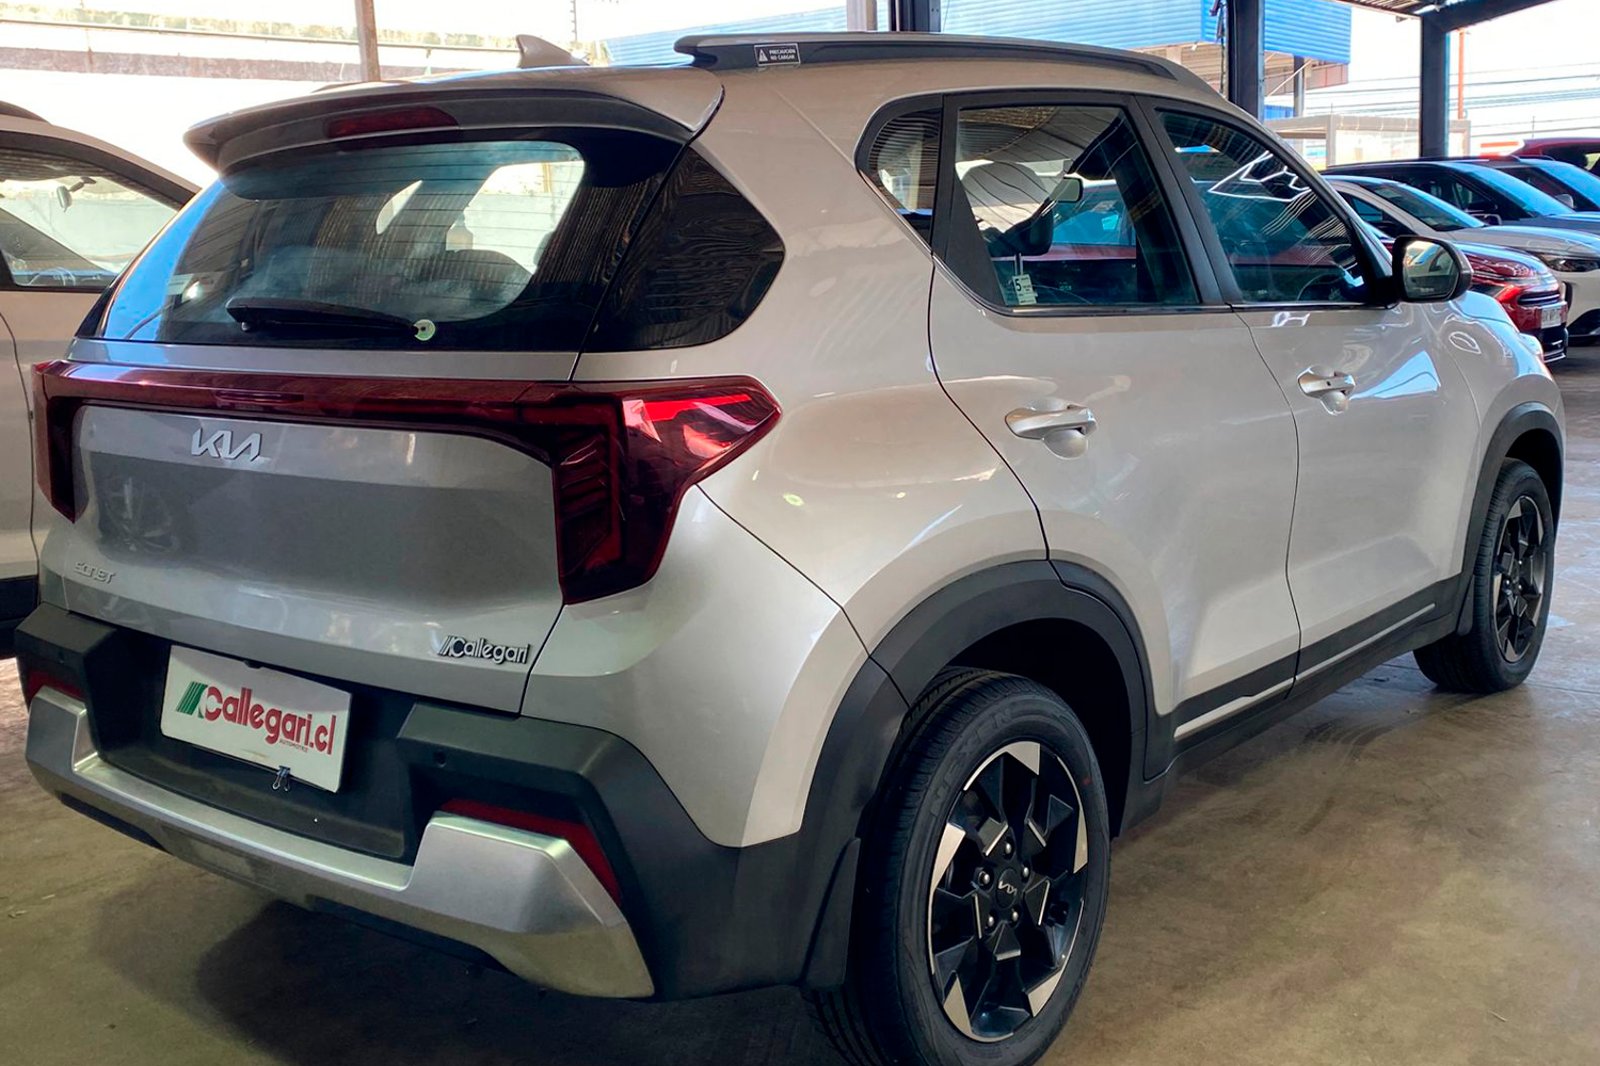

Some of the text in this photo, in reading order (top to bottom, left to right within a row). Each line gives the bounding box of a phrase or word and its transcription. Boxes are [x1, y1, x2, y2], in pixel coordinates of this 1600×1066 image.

[191, 427, 262, 462] KIA
[449, 635, 531, 665] Callegari
[205, 686, 337, 755] Callegari.cl
